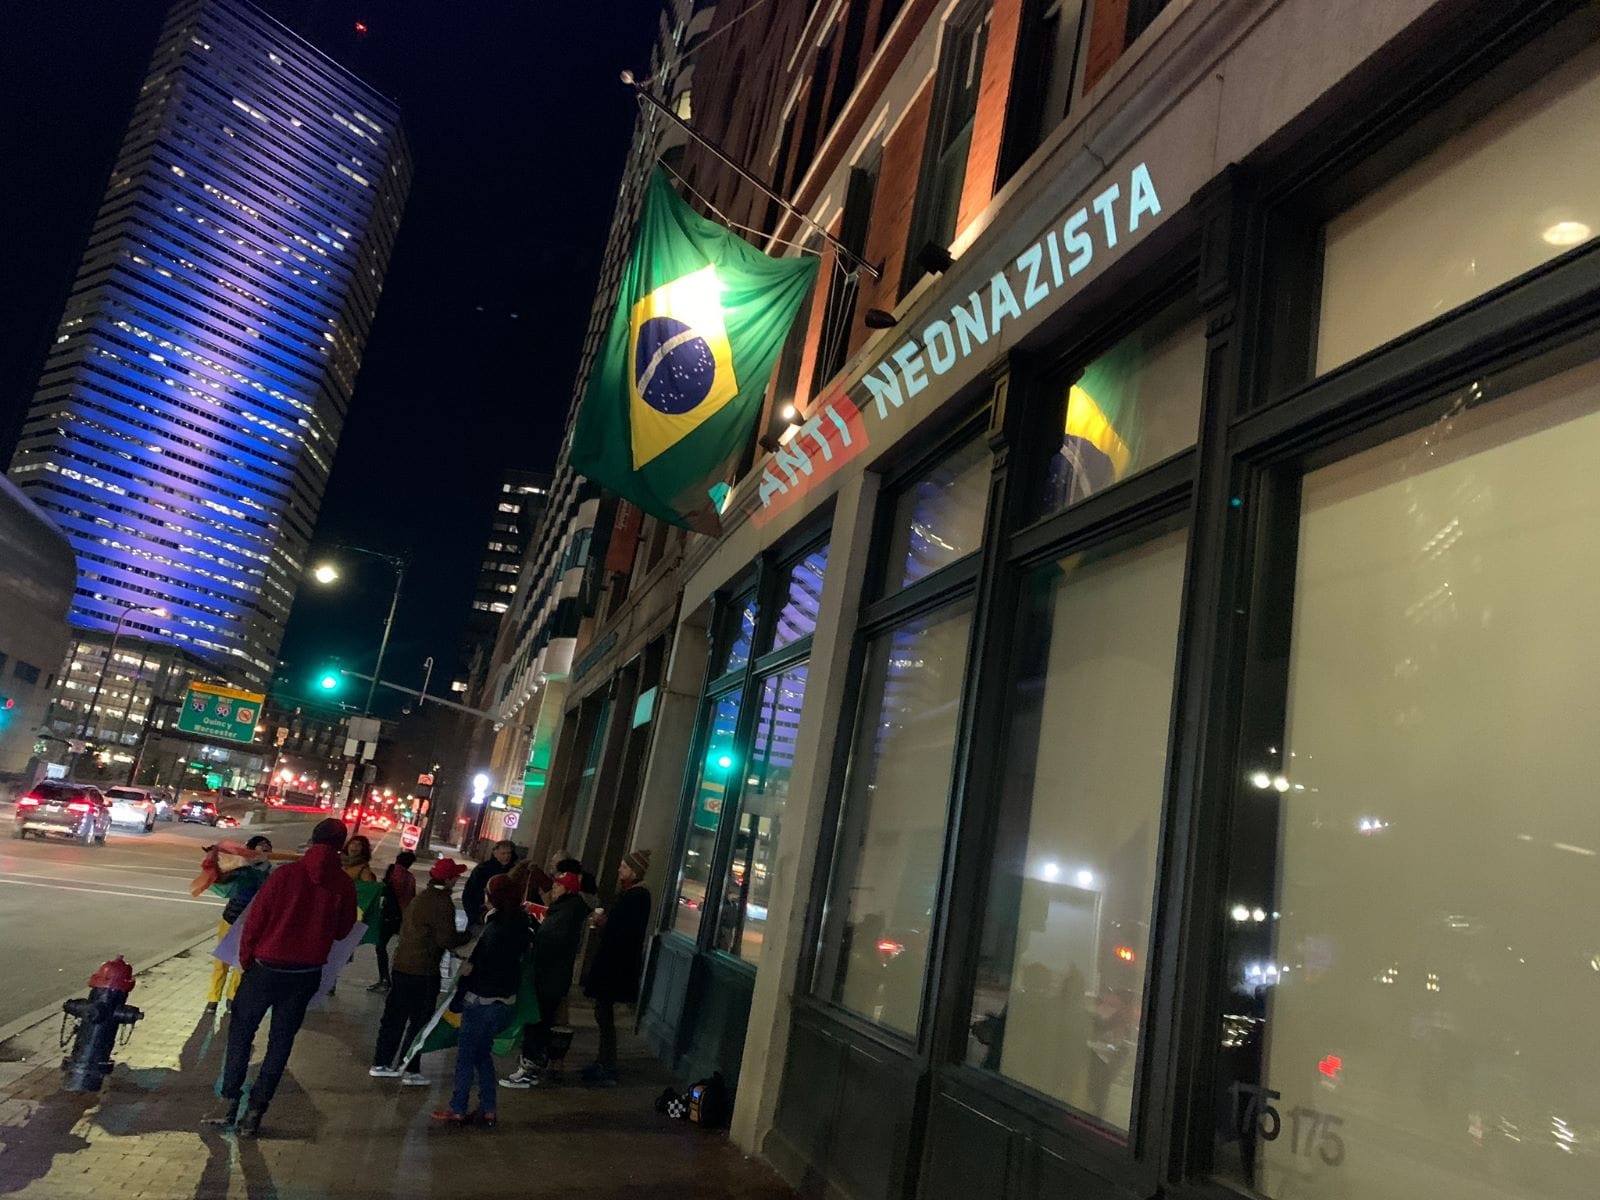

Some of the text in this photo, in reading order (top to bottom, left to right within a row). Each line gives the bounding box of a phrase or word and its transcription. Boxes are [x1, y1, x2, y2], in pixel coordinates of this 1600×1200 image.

[758, 162, 1161, 508] ANTI NEONAZISTA
[193, 702, 205, 712] 93
[217, 707, 229, 717] 90
[203, 717, 232, 730] Quincy
